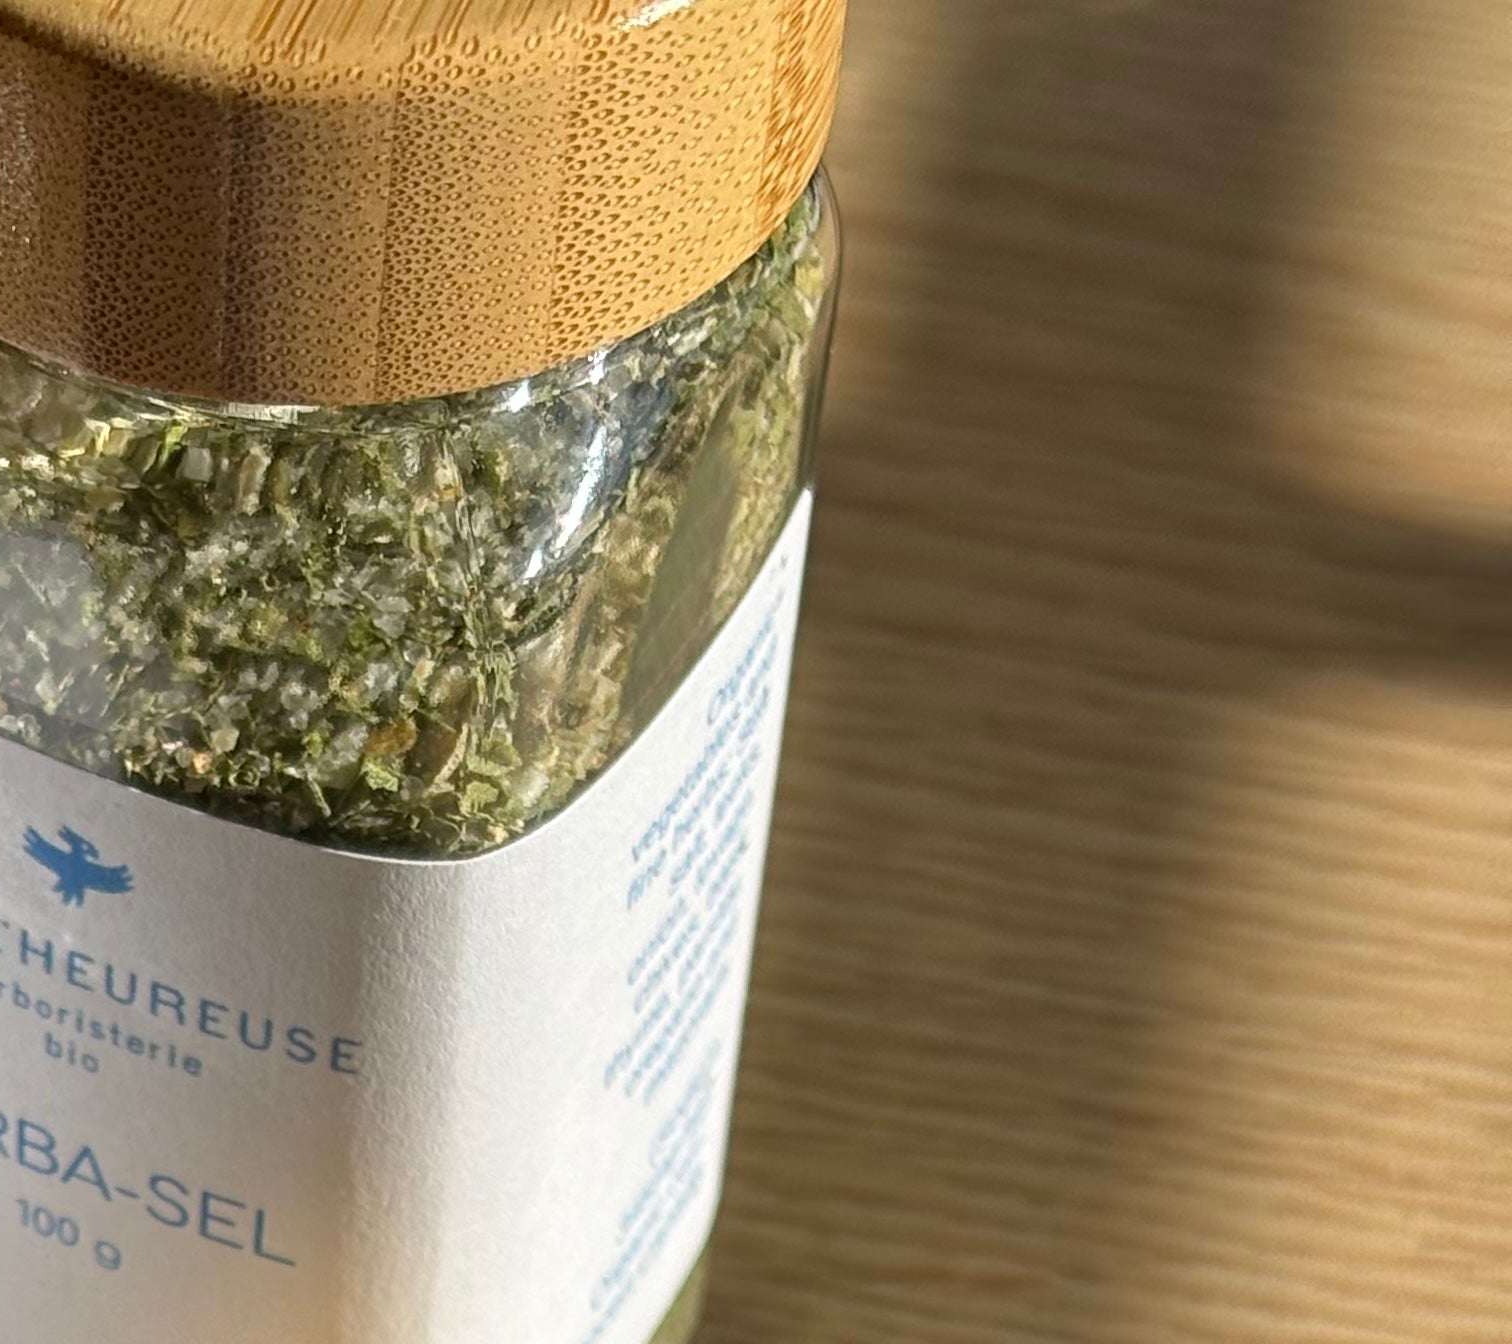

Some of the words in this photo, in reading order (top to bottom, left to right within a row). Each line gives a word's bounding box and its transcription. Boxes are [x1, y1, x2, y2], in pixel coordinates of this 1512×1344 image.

[44, 1031, 99, 1074] bio
[16, 1198, 80, 1248] 100
[95, 1239, 122, 1271] g
